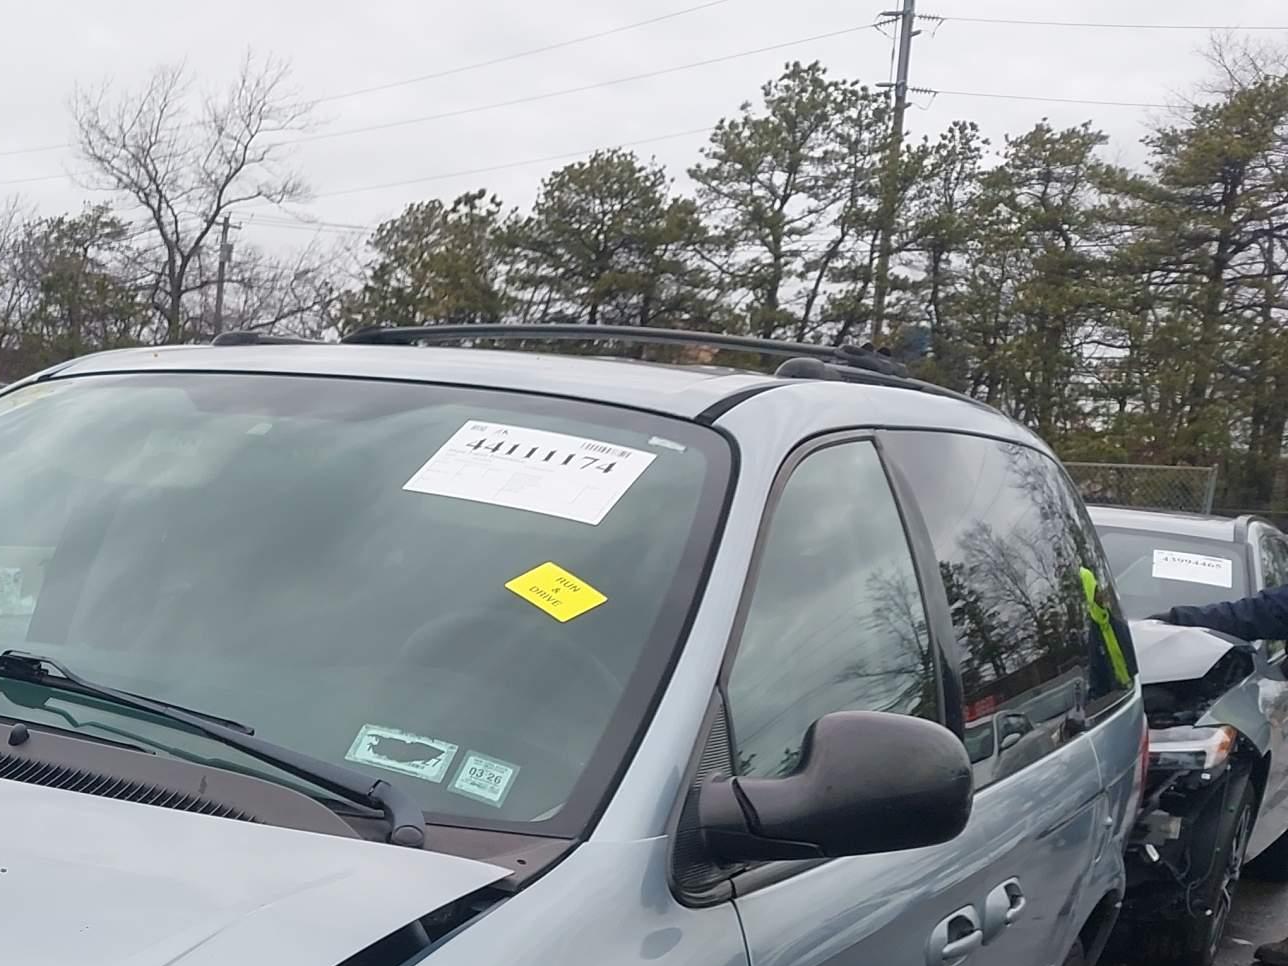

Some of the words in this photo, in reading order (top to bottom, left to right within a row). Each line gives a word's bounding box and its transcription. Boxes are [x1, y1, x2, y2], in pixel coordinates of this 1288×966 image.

[466, 438, 617, 474] 44111174
[556, 576, 580, 592] RUN
[529, 586, 562, 607] DRIVE
